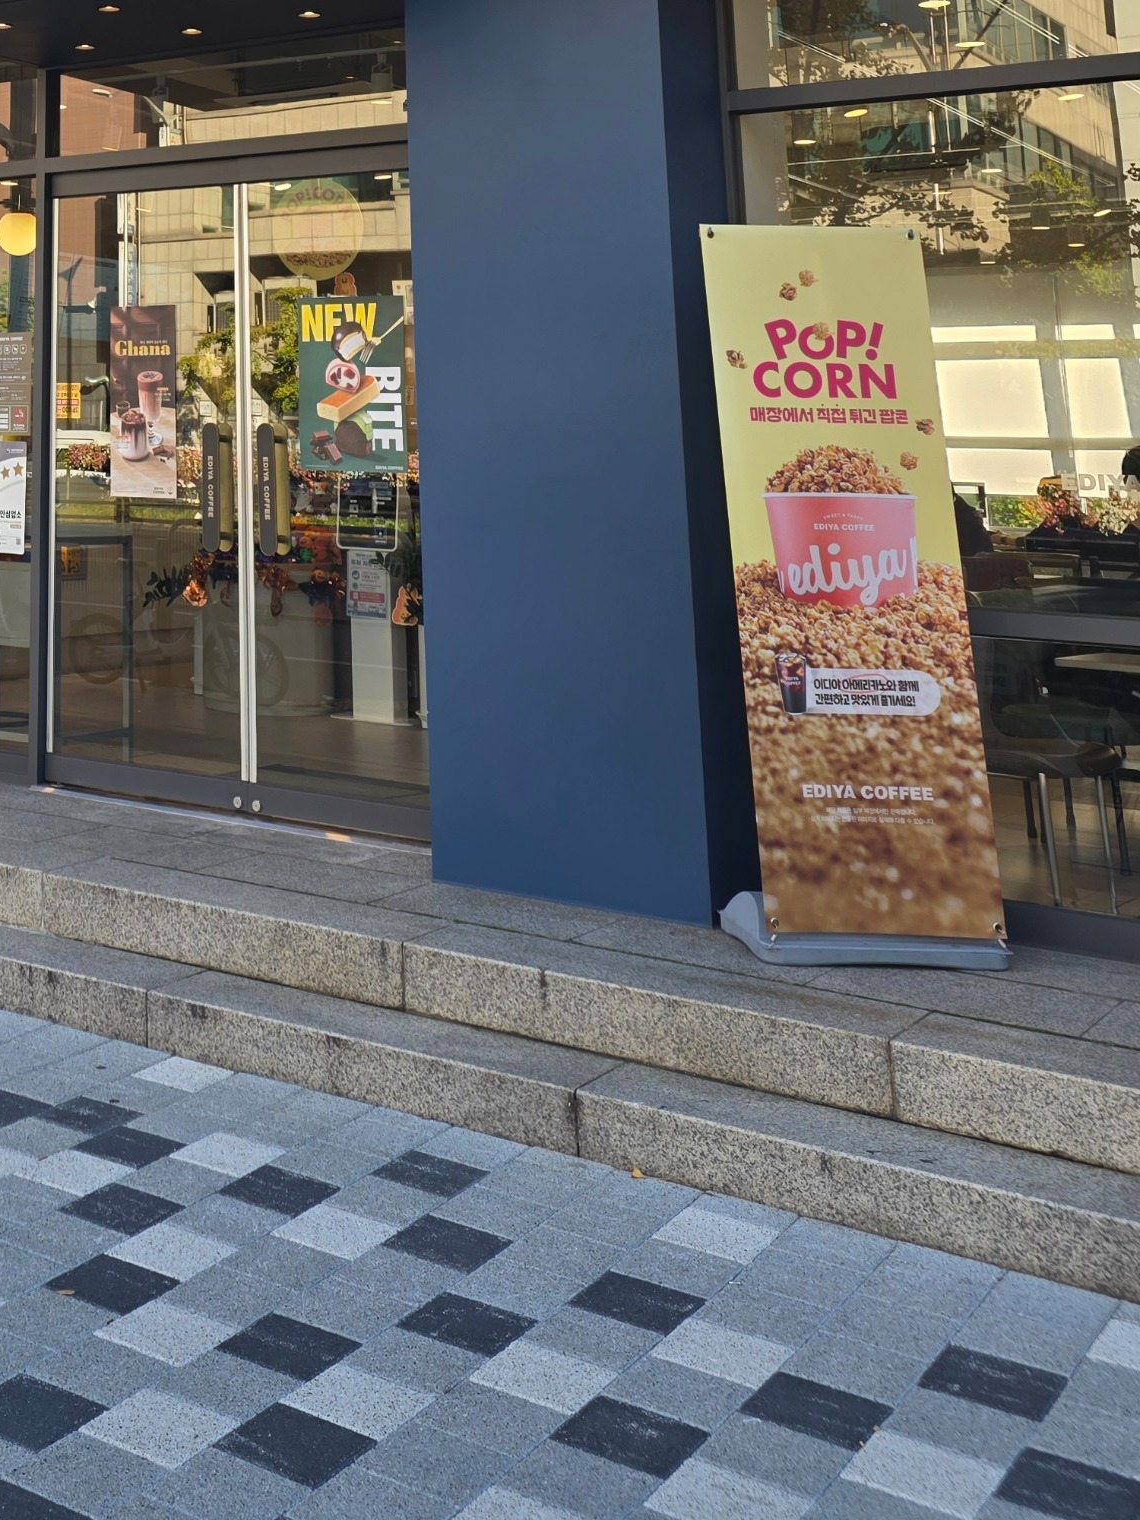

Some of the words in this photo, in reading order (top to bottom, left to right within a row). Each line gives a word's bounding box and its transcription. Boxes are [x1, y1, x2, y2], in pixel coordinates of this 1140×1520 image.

[301, 302, 377, 342] NEW
[114, 339, 171, 357] Ghana
[764, 318, 884, 361] POP!
[753, 361, 898, 400] CORN
[365, 366, 404, 452] BITE
[750, 407, 814, 423] 매장에서
[817, 406, 847, 424] 직접
[849, 408, 877, 424] 튀긴
[879, 409, 909, 425] 팝콘
[262, 456, 270, 482] EDIYA
[1060, 473, 1140, 493] EDIYA
[263, 485, 271, 521] COFFEE
[813, 523, 840, 531] EDIYA
[841, 523, 876, 532] COFFEE
[787, 543, 907, 606] ediya
[813, 678, 840, 691] 이디야
[842, 679, 897, 692] 아메리카노와
[898, 680, 920, 692] 함께
[815, 693, 850, 706] 간편하고
[851, 694, 880, 707] 맛있게
[802, 784, 857, 799] EDIYA
[860, 785, 935, 801] COFFEE
